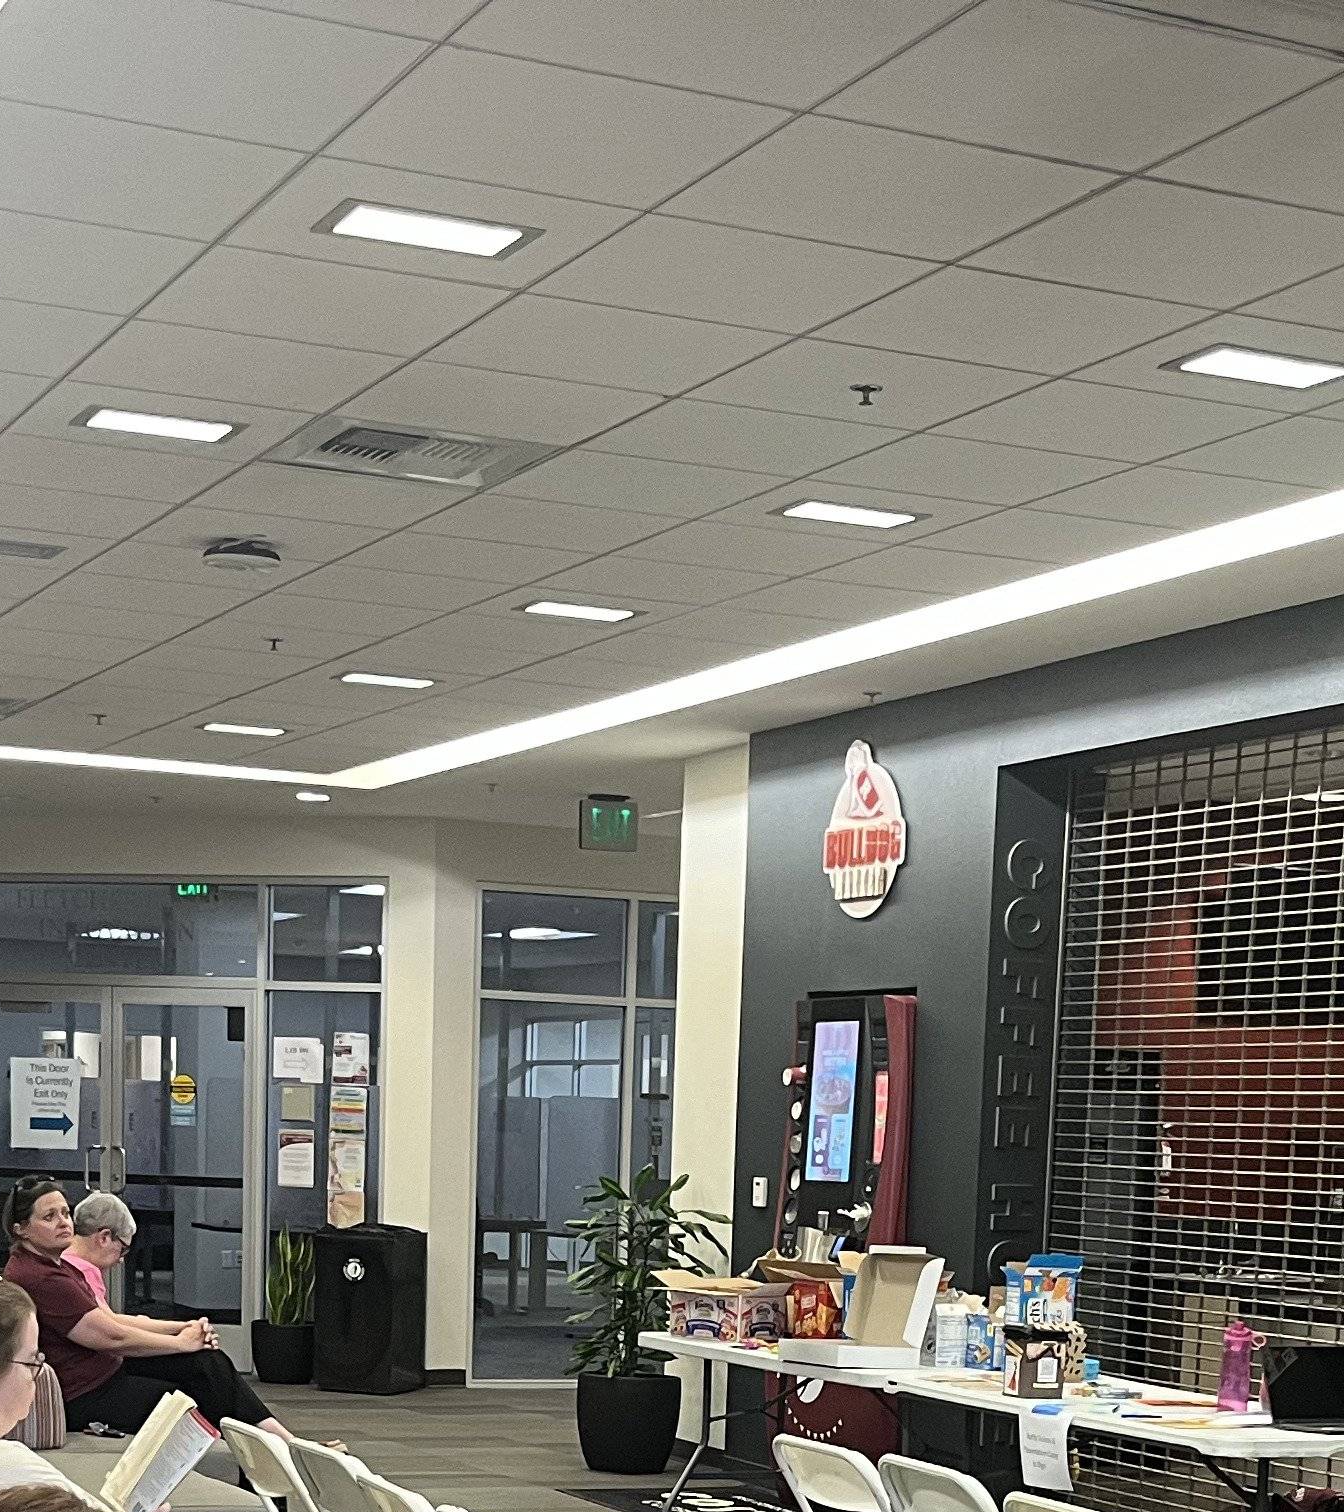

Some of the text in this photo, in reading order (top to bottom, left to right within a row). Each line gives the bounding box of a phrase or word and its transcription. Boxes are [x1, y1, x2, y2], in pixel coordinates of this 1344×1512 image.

[825, 820, 902, 870] BULLDOG
[994, 838, 1051, 1148] COFFEE
[30, 1063, 70, 1073] This Door
[35, 1077, 73, 1088] Currently
[51, 1089, 68, 1100] Only
